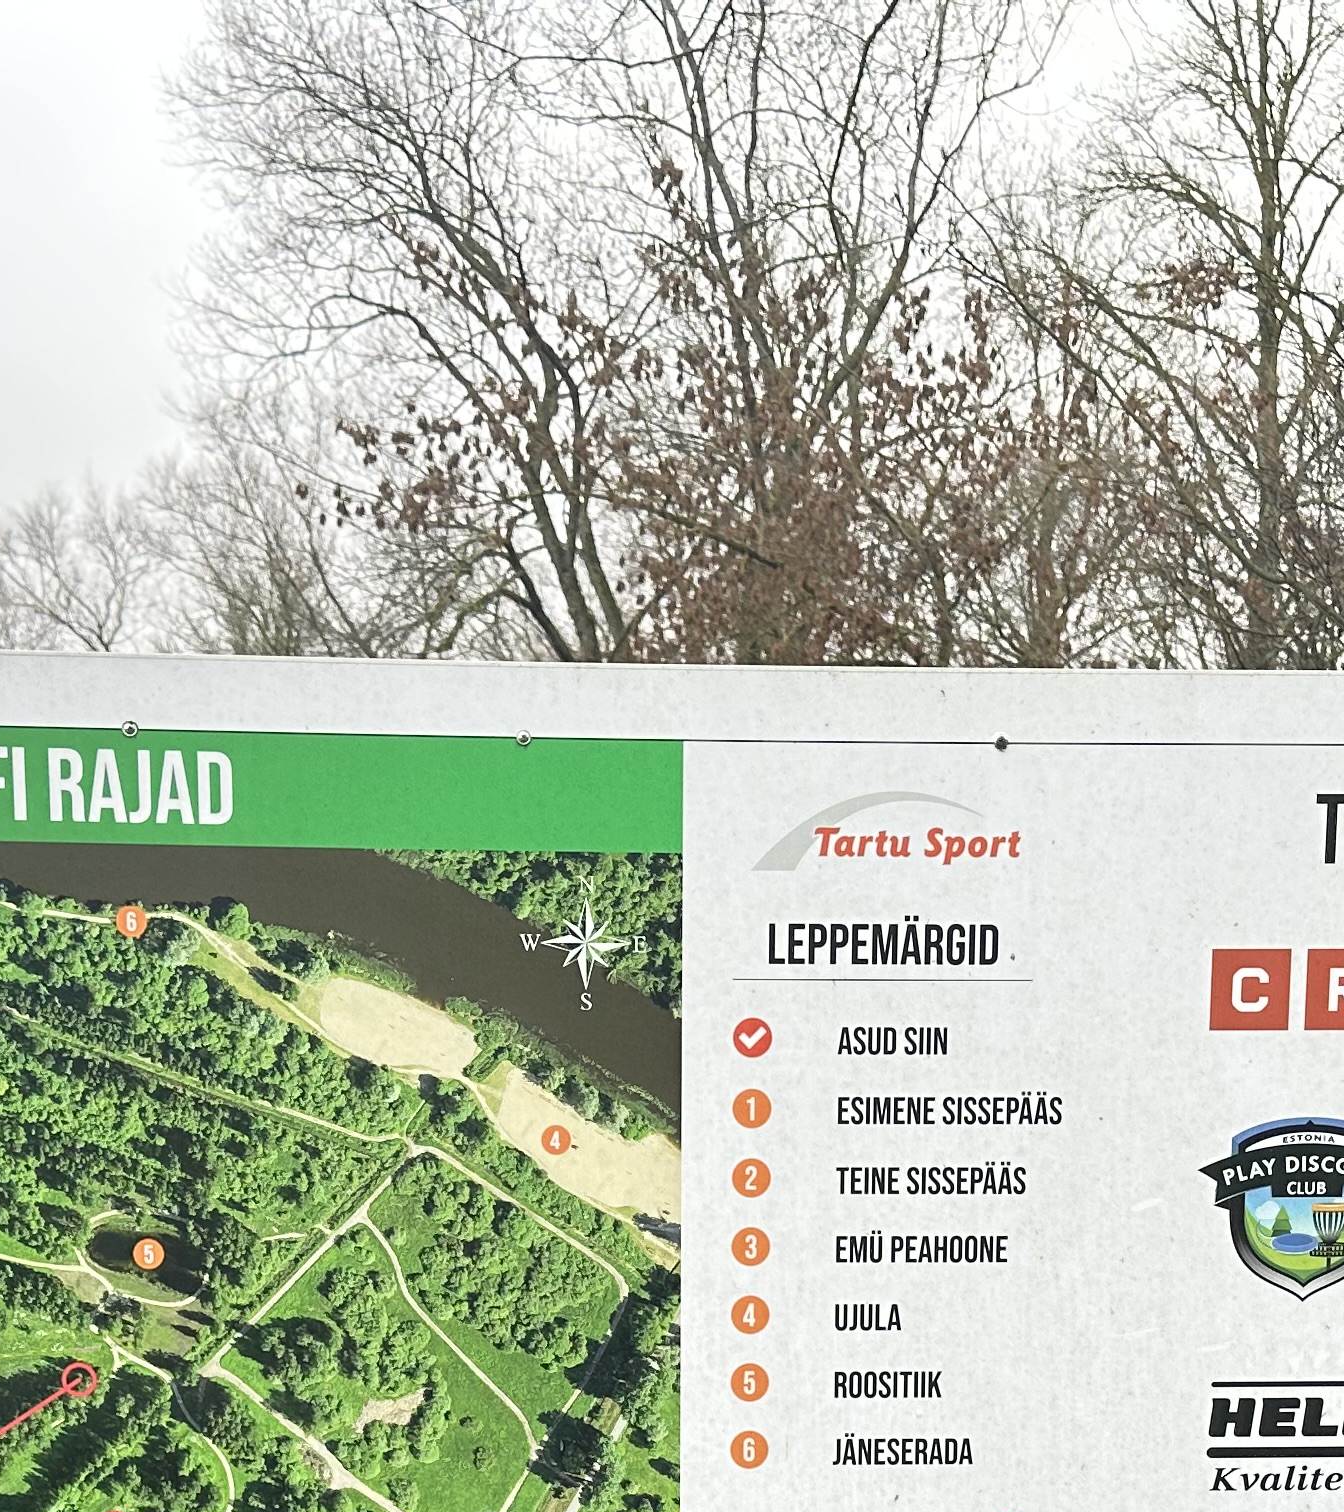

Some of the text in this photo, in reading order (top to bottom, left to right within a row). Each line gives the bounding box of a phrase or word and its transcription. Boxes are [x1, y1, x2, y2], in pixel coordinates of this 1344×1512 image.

[47, 747, 234, 825] RAJAD
[815, 826, 1021, 865] Tartu Sport
[578, 875, 594, 893] N
[519, 933, 646, 953] W E
[768, 915, 999, 966] LEPPEMÄRGID
[580, 992, 593, 1011] S
[837, 1026, 948, 1056] ASUD SIIN
[747, 1091, 1063, 1125] 1 ESIMENE SISSEPÄÄS
[1282, 1133, 1336, 1144] ESTONIA
[745, 1161, 1027, 1195] 2 TEINE SISSEPÄÄS
[1222, 1157, 1276, 1186] PLAY
[1286, 1180, 1327, 1196] CLUB
[745, 1230, 1009, 1265] 3 EMÜ PEAHOONE
[743, 1303, 902, 1332] 4 UJULA
[744, 1371, 942, 1399] 5 ROOSITIIK
[743, 1432, 973, 1466] 6 JÄNESERADA
